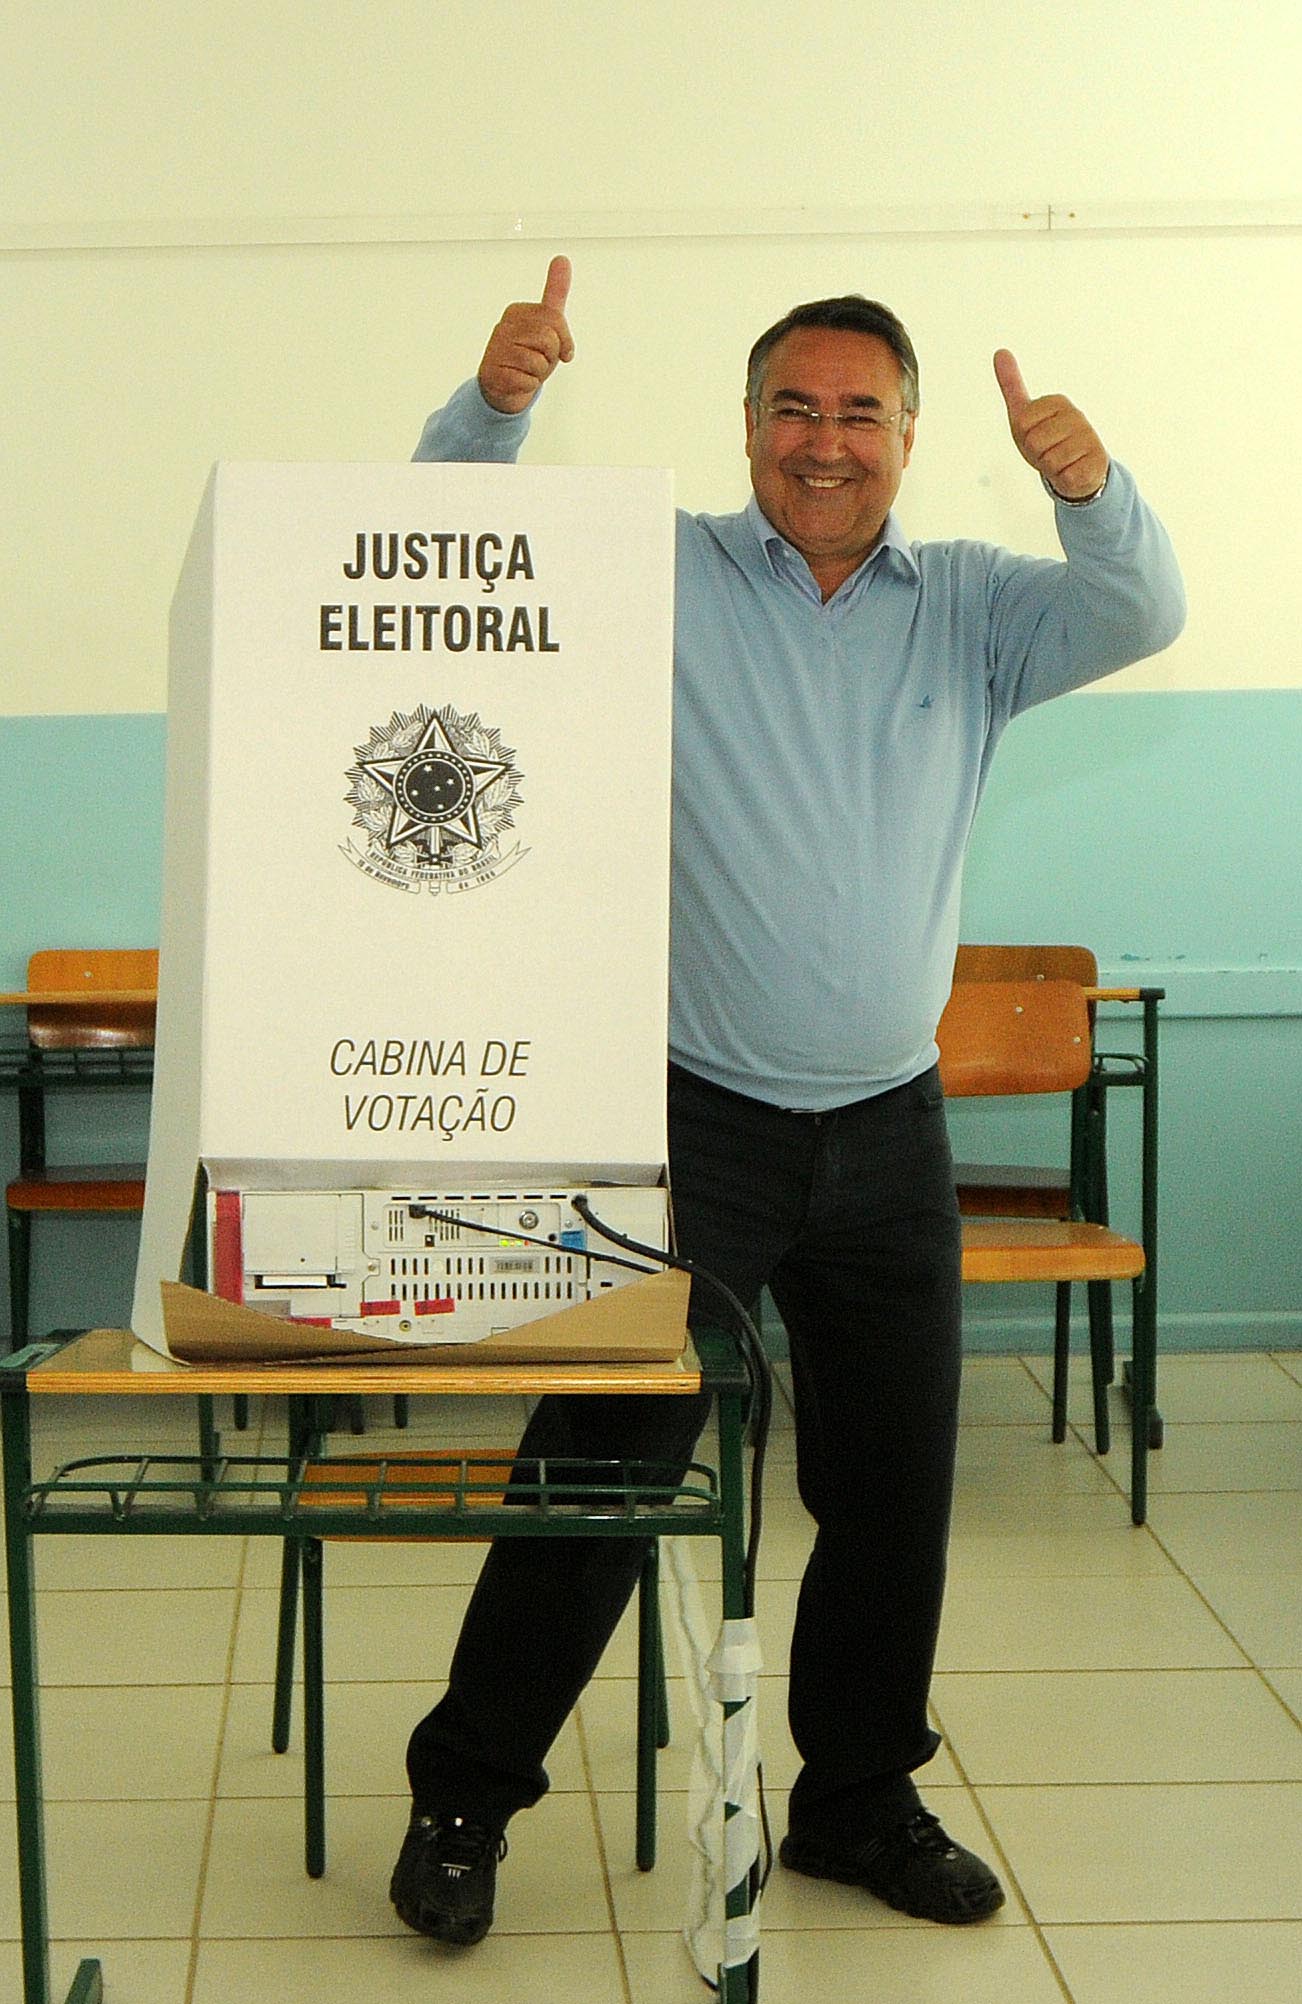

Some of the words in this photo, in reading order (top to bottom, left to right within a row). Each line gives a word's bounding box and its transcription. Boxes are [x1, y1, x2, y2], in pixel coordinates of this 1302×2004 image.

[343, 532, 534, 593] JUSTIÇA
[320, 605, 560, 652] ELEITORAL
[330, 1039, 465, 1076] CABINA
[480, 1040, 531, 1076] DE
[344, 1088, 516, 1141] VOTAÇÃO
